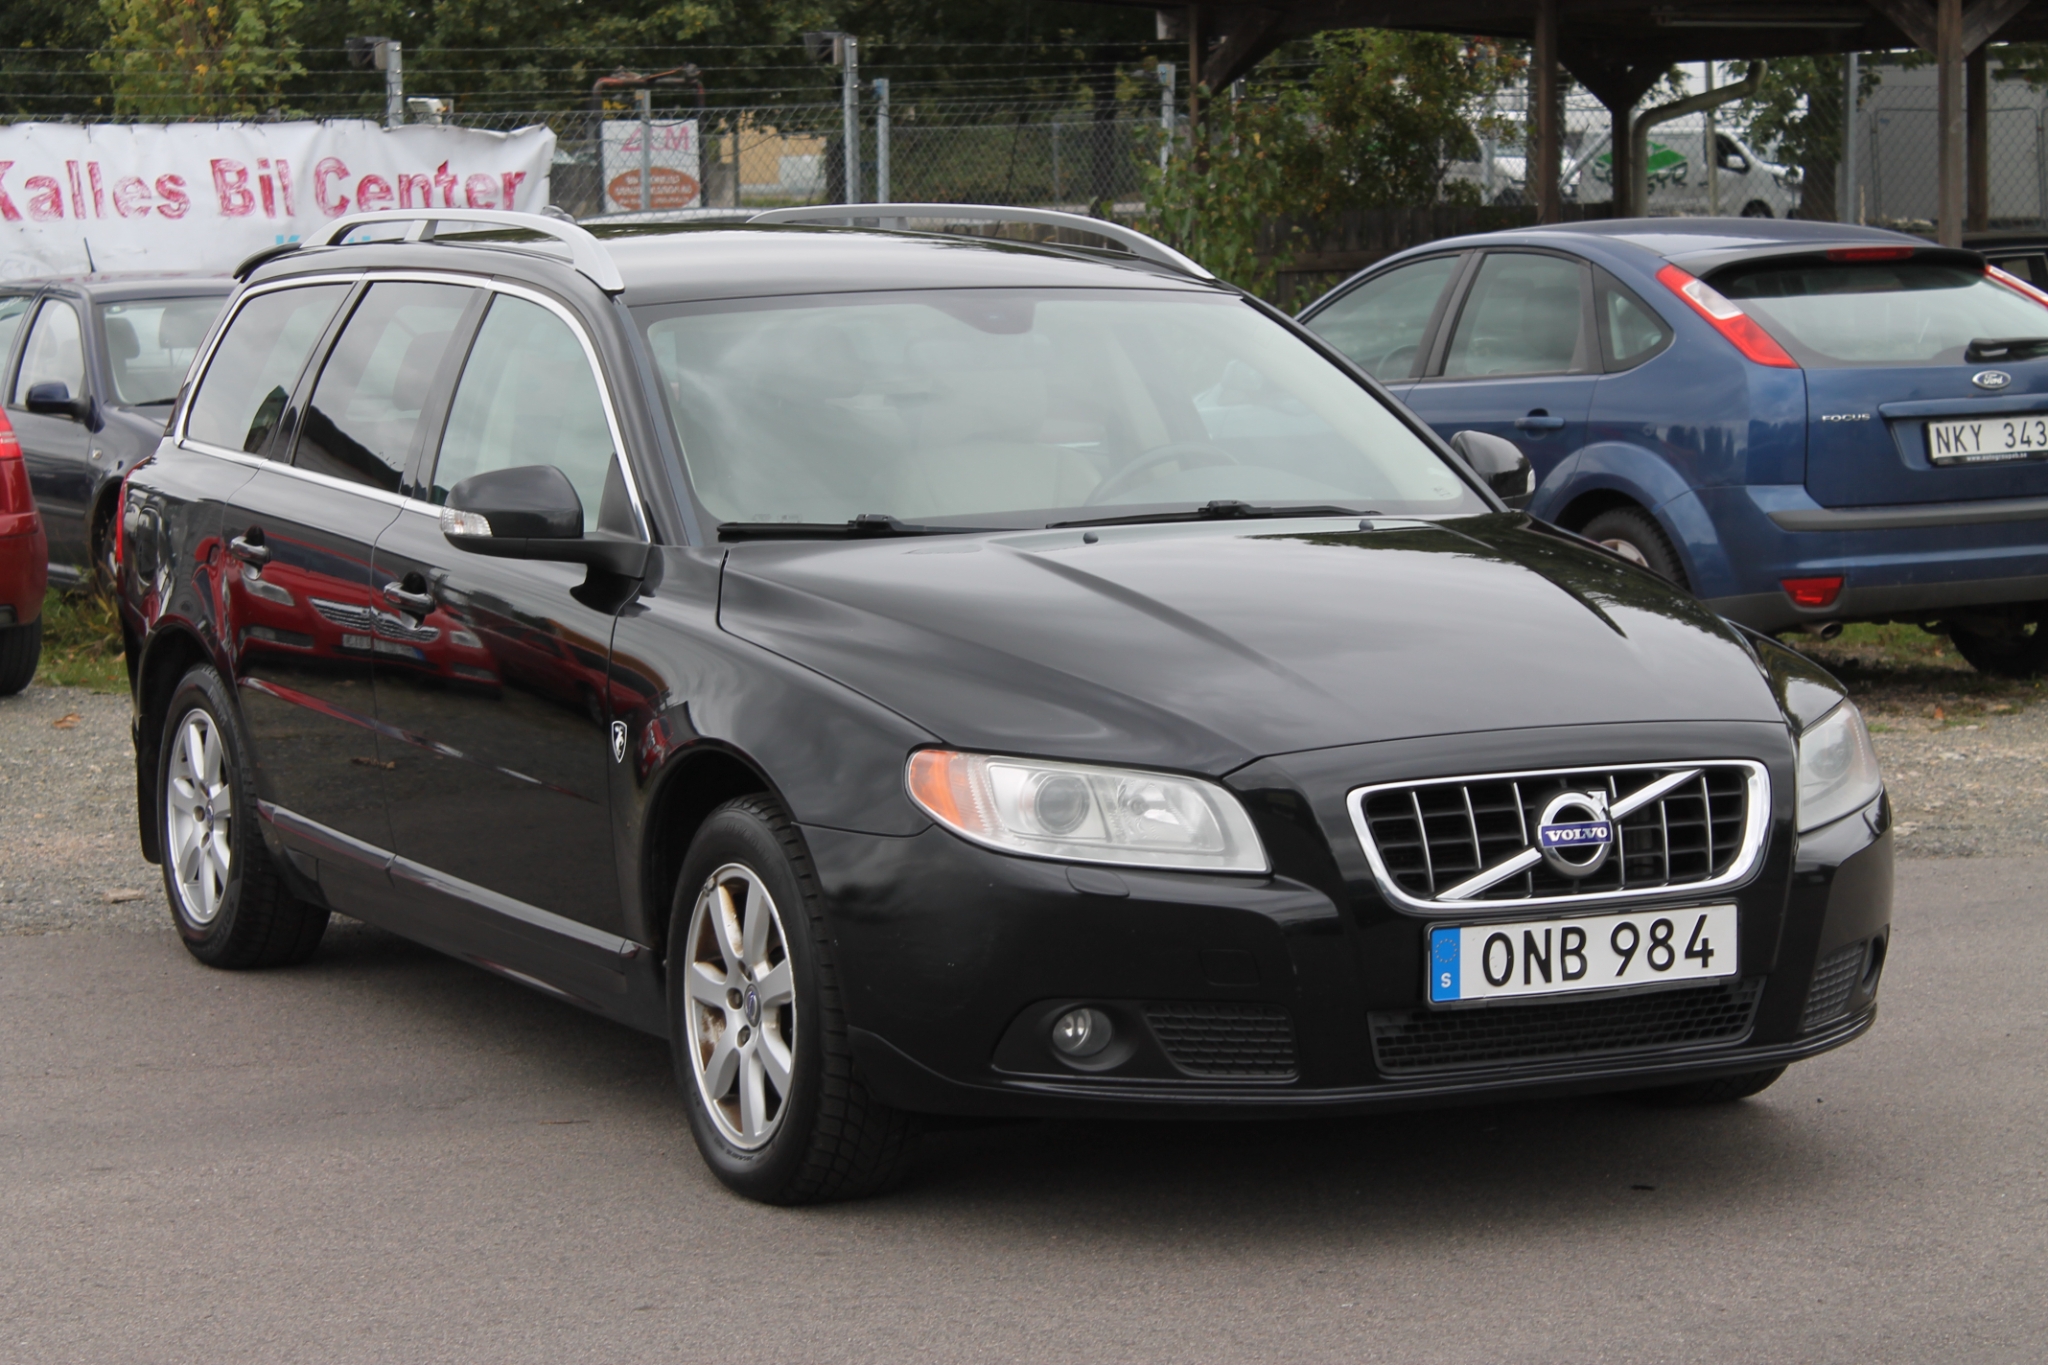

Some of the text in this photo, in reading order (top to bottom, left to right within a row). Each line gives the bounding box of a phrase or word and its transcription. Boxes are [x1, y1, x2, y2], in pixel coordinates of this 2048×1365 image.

[210, 157, 295, 219] Bil
[314, 156, 527, 218] Center
[1983, 373, 2004, 385] Ford
[1822, 412, 1871, 423] FOCUS
[1935, 420, 2048, 454] NKY 343
[1545, 826, 1608, 841] VOLVO
[1482, 914, 1714, 987] ONB 984
[1441, 972, 1452, 988] S
